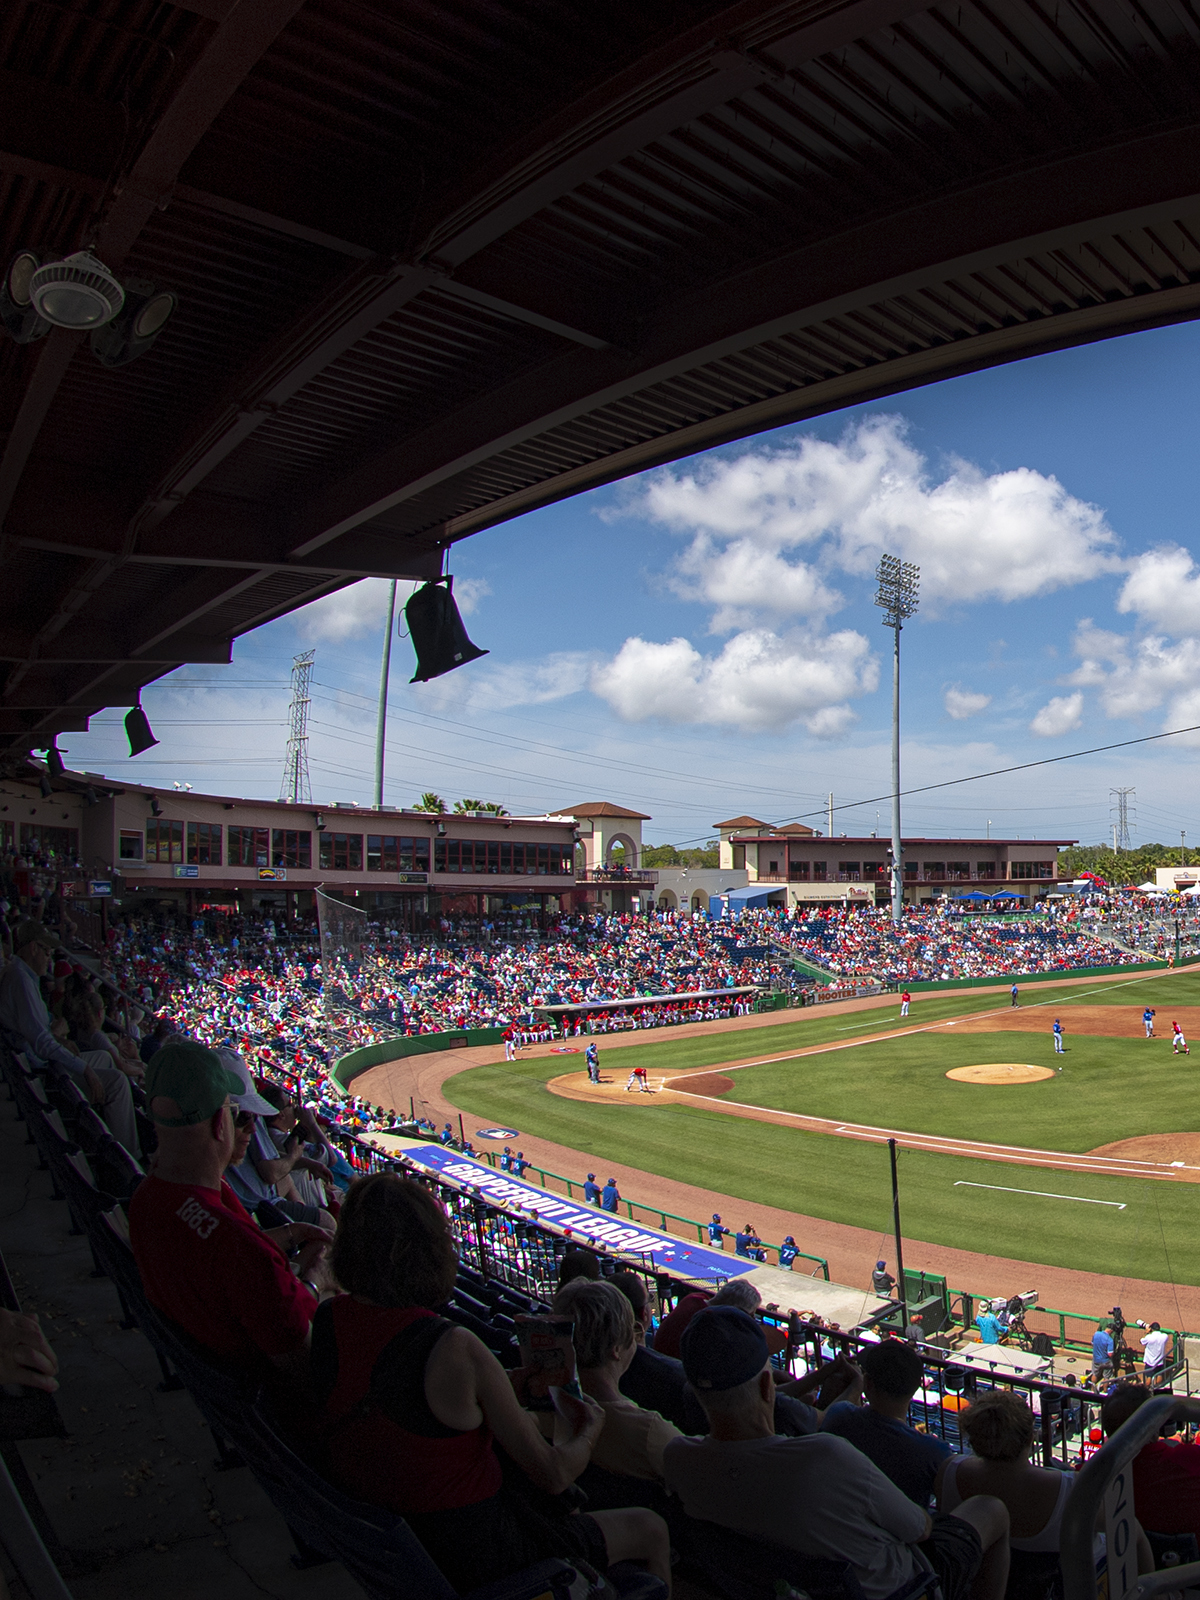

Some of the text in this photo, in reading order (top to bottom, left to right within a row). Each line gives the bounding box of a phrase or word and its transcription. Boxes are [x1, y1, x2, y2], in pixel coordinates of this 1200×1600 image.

[818, 989, 857, 1001] HOOTERS
[175, 1197, 219, 1239] 1883
[441, 1163, 676, 1254] GRAPEFRUIT LEAGUE
[1112, 1473, 1130, 1599] 201
